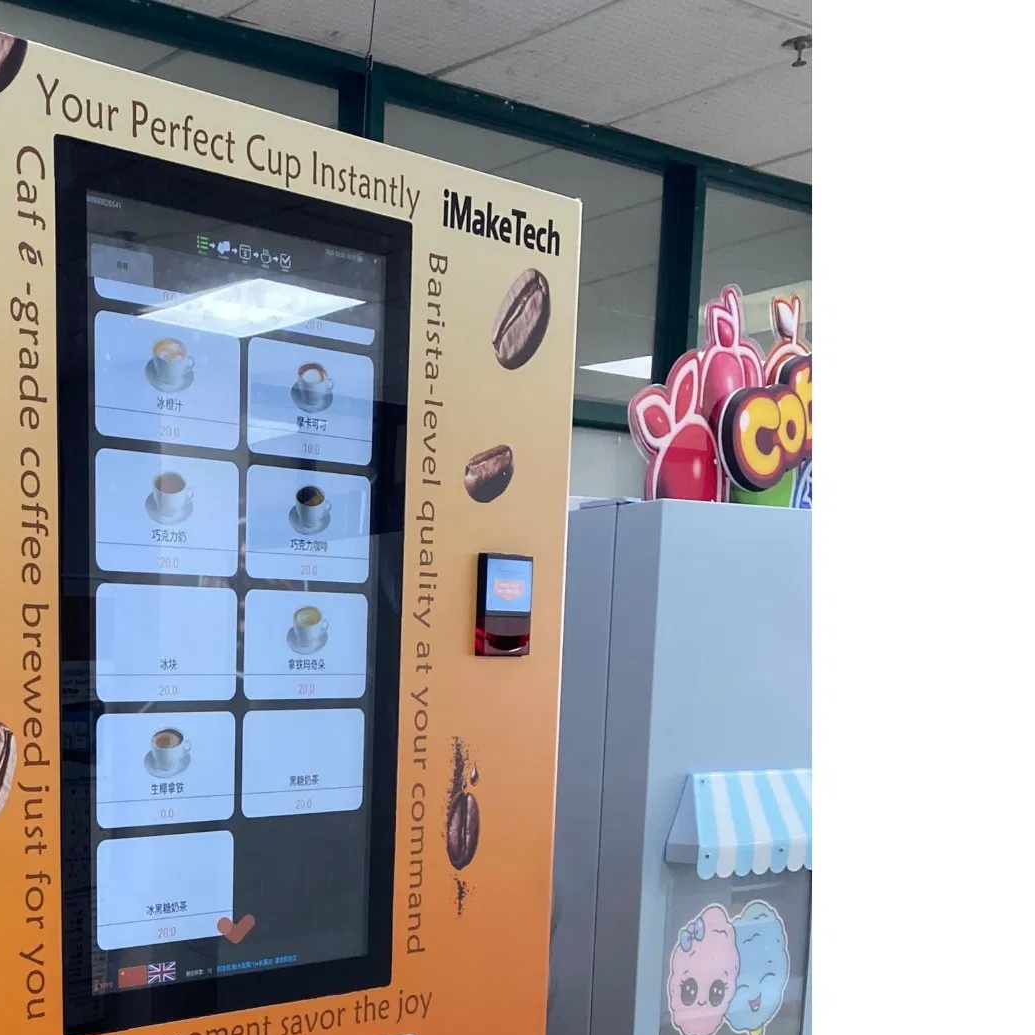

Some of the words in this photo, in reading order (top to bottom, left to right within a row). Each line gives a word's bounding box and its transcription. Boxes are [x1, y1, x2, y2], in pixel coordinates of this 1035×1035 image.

[36, 73, 119, 132] Your
[131, 99, 236, 164] Perfect
[246, 133, 302, 188] Cup
[312, 149, 421, 220] Instantly
[442, 188, 561, 257] iMakeTech
[421, 252, 449, 487] Barista-level
[156, 396, 184, 413] 冰橙汁
[159, 424, 180, 438] 20.0
[303, 443, 321, 456] 10.0
[19, 446, 50, 585] coffee
[152, 529, 187, 545] 巧克力奶
[290, 538, 329, 553] 巧克力咖啡
[159, 557, 179, 569] 20.0
[300, 564, 318, 577] 20.0
[412, 500, 439, 629] quality
[159, 657, 177, 671] 冰块
[287, 658, 326, 672] 拿铁玛奇朵
[415, 640, 433, 674] at
[21, 602, 51, 767] brewed
[158, 684, 178, 697] 20.0
[297, 683, 316, 695] 20.0
[409, 686, 430, 771] your
[150, 781, 185, 796] 生椰拿铁
[289, 773, 320, 788] 黑糖奶茶
[295, 799, 313, 810] 20.0
[18, 781, 50, 855] just
[160, 808, 174, 820] 0.0
[406, 782, 427, 955] command
[24, 869, 52, 931] for
[146, 900, 188, 917] 冰黑糖奶茶
[157, 926, 177, 939] 20.0
[19, 942, 46, 1021] you
[353, 994, 391, 1024] the
[395, 988, 433, 1025] joy
